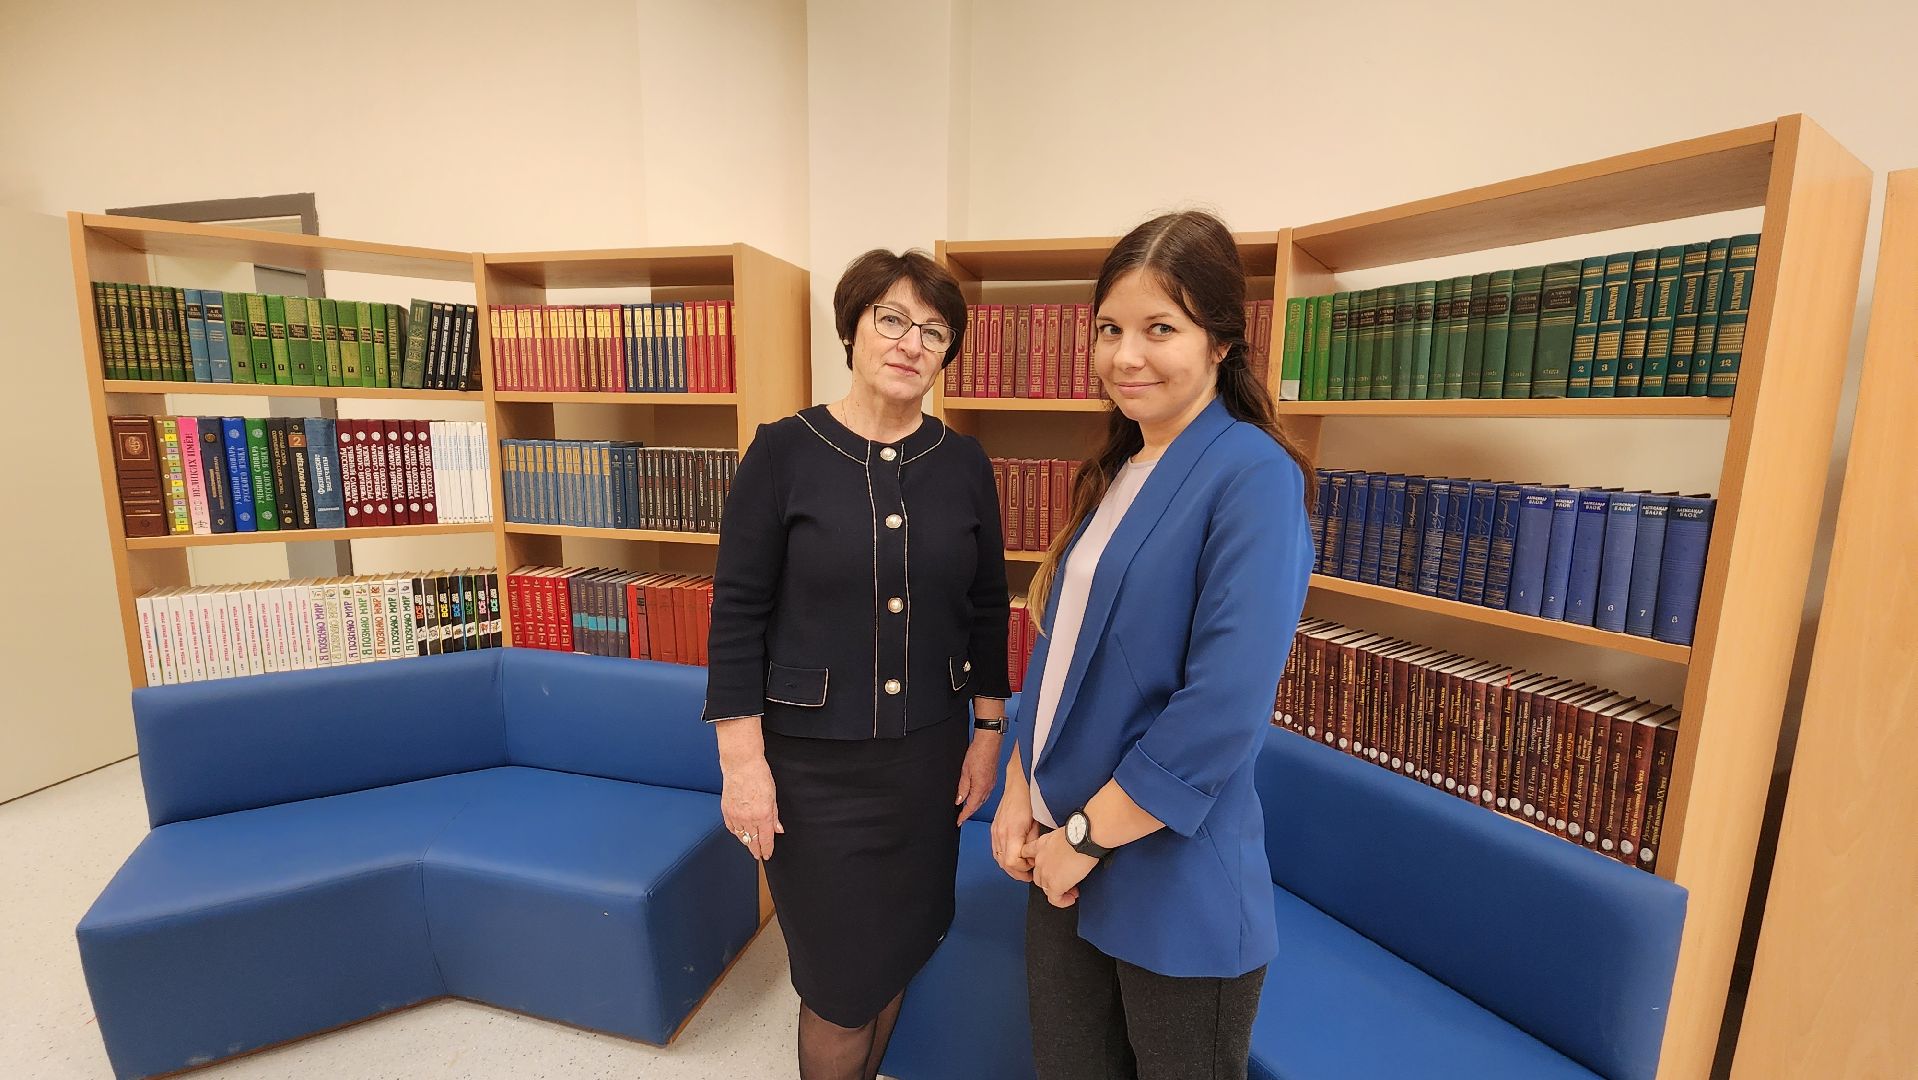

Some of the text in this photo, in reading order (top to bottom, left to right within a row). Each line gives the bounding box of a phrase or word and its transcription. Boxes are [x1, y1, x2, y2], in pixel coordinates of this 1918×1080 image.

[1578, 365, 1585, 373] 2
[1601, 363, 1608, 371] 3
[1627, 362, 1633, 370] 6
[1652, 362, 1659, 370] 7
[1676, 360, 1684, 368] 8
[1720, 359, 1732, 367] 12
[293, 437, 302, 445] 2
[228, 445, 242, 505] УЧЕБНЫЙ СЛОВАРЬ
[237, 447, 251, 502] РУССКОГО ЯЗЫКА
[251, 446, 265, 504] УЧЕБНЫЙ СЛОВАРЬ
[260, 446, 273, 501] РУССКОГО ЯЗЫКА
[340, 447, 349, 480] РУССКОГО
[346, 445, 359, 504] УЧЕБНЫЙ СЛОВАРЬ
[362, 445, 374, 499] РУССКОГО ЯЗЫКА
[371, 443, 382, 501] УЧЕБНЫЙ СЛОВАРЬ
[377, 446, 389, 499] РУССКОГО ЯЗЫКА
[387, 443, 398, 500] УЧЕБНЫЙ СЛОВАРЬ
[394, 445, 405, 498] РУССКОГО ЯЗЫКА
[403, 443, 415, 500] УЧЕБНЫЙ СЛОВАРЬ
[358, 472, 368, 501] УЧЕБНЫЙ
[412, 467, 421, 498] РУССКОГО
[420, 471, 429, 500] УЧЕБНЫЙ
[426, 467, 434, 497] РУССКОГО
[314, 603, 325, 620] МИР
[344, 601, 353, 618] МИР
[358, 598, 368, 614] МИР
[373, 598, 382, 614] МИР
[388, 597, 397, 613] МИР
[402, 596, 411, 611] МИР
[316, 622, 328, 653] ПОЗНАЮ
[347, 620, 357, 650] ПОЗНАЮ
[360, 617, 371, 647] ПОЗНАЮ
[374, 617, 385, 647] ПОЗНАЮ
[390, 616, 399, 645] ПОЗНАЮ
[404, 613, 414, 643] ПОЗНАЮ
[1528, 766, 1537, 785] Гоголь
[1612, 762, 1620, 771] XX
[1637, 770, 1645, 781] века
[1550, 777, 1558, 798] Горький
[1559, 769, 1569, 797] Грибоедов
[1574, 764, 1585, 800] Достоевский
[1634, 782, 1643, 793] XX
[1656, 789, 1665, 800] XX
